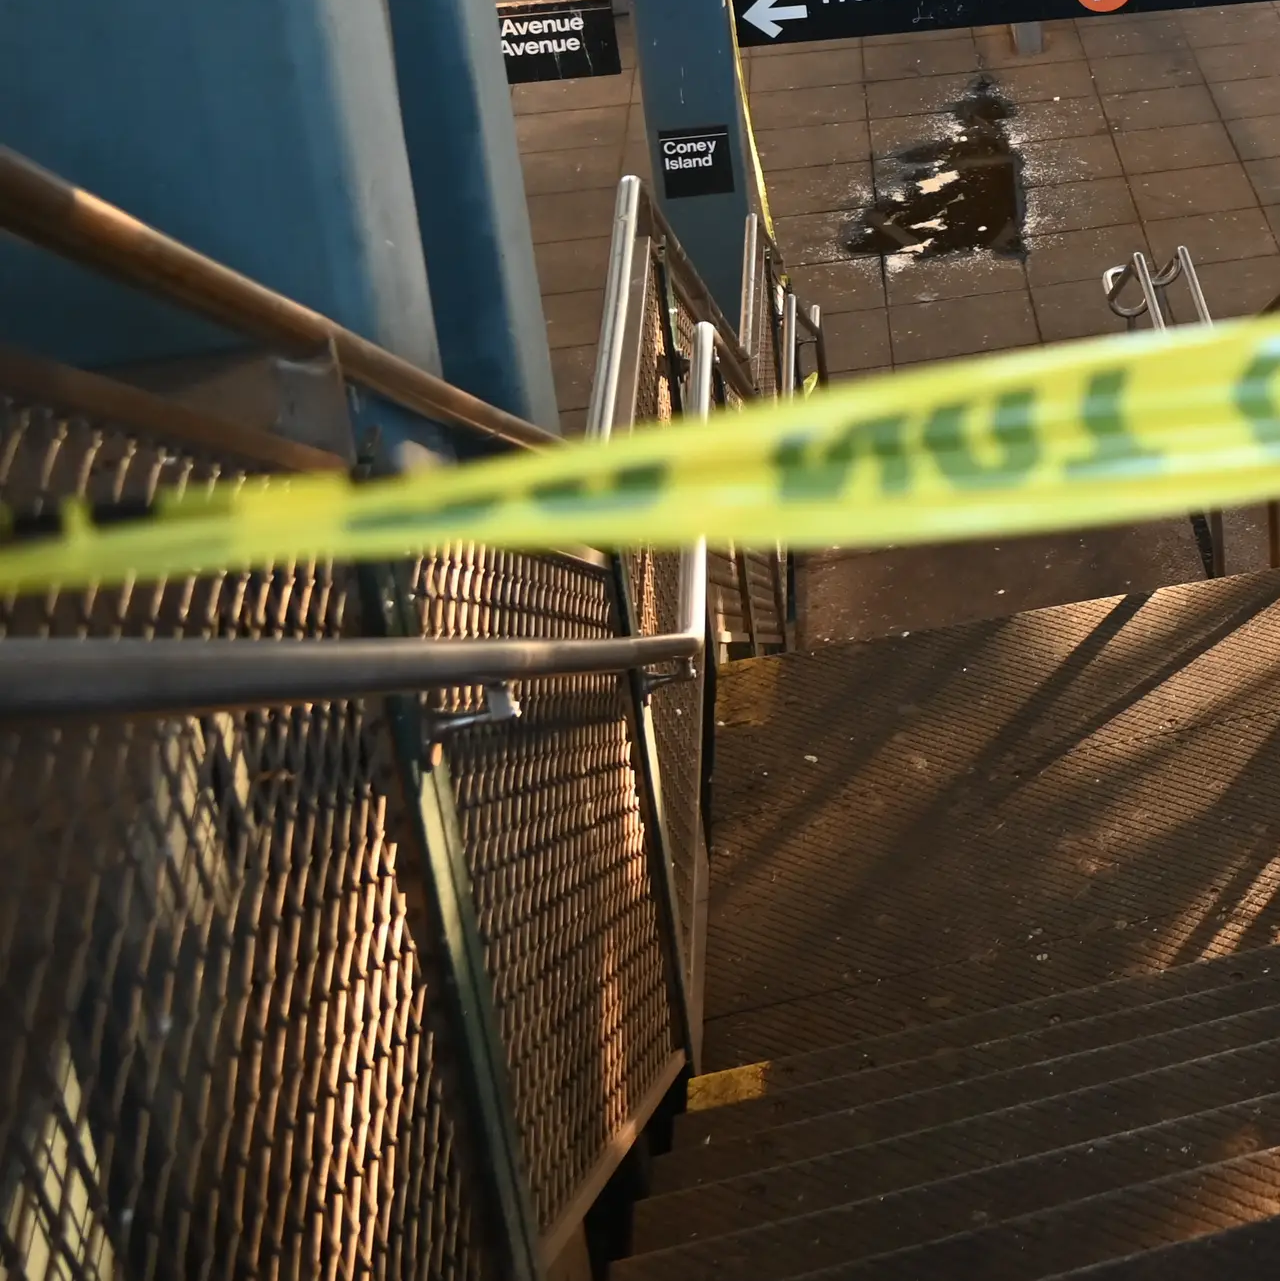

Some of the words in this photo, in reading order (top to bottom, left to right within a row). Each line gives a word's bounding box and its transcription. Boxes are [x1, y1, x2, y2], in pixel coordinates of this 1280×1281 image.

[501, 16, 584, 37] Avenue
[501, 37, 581, 56] Avenue
[663, 140, 717, 155] Coney
[664, 154, 713, 170] Island
